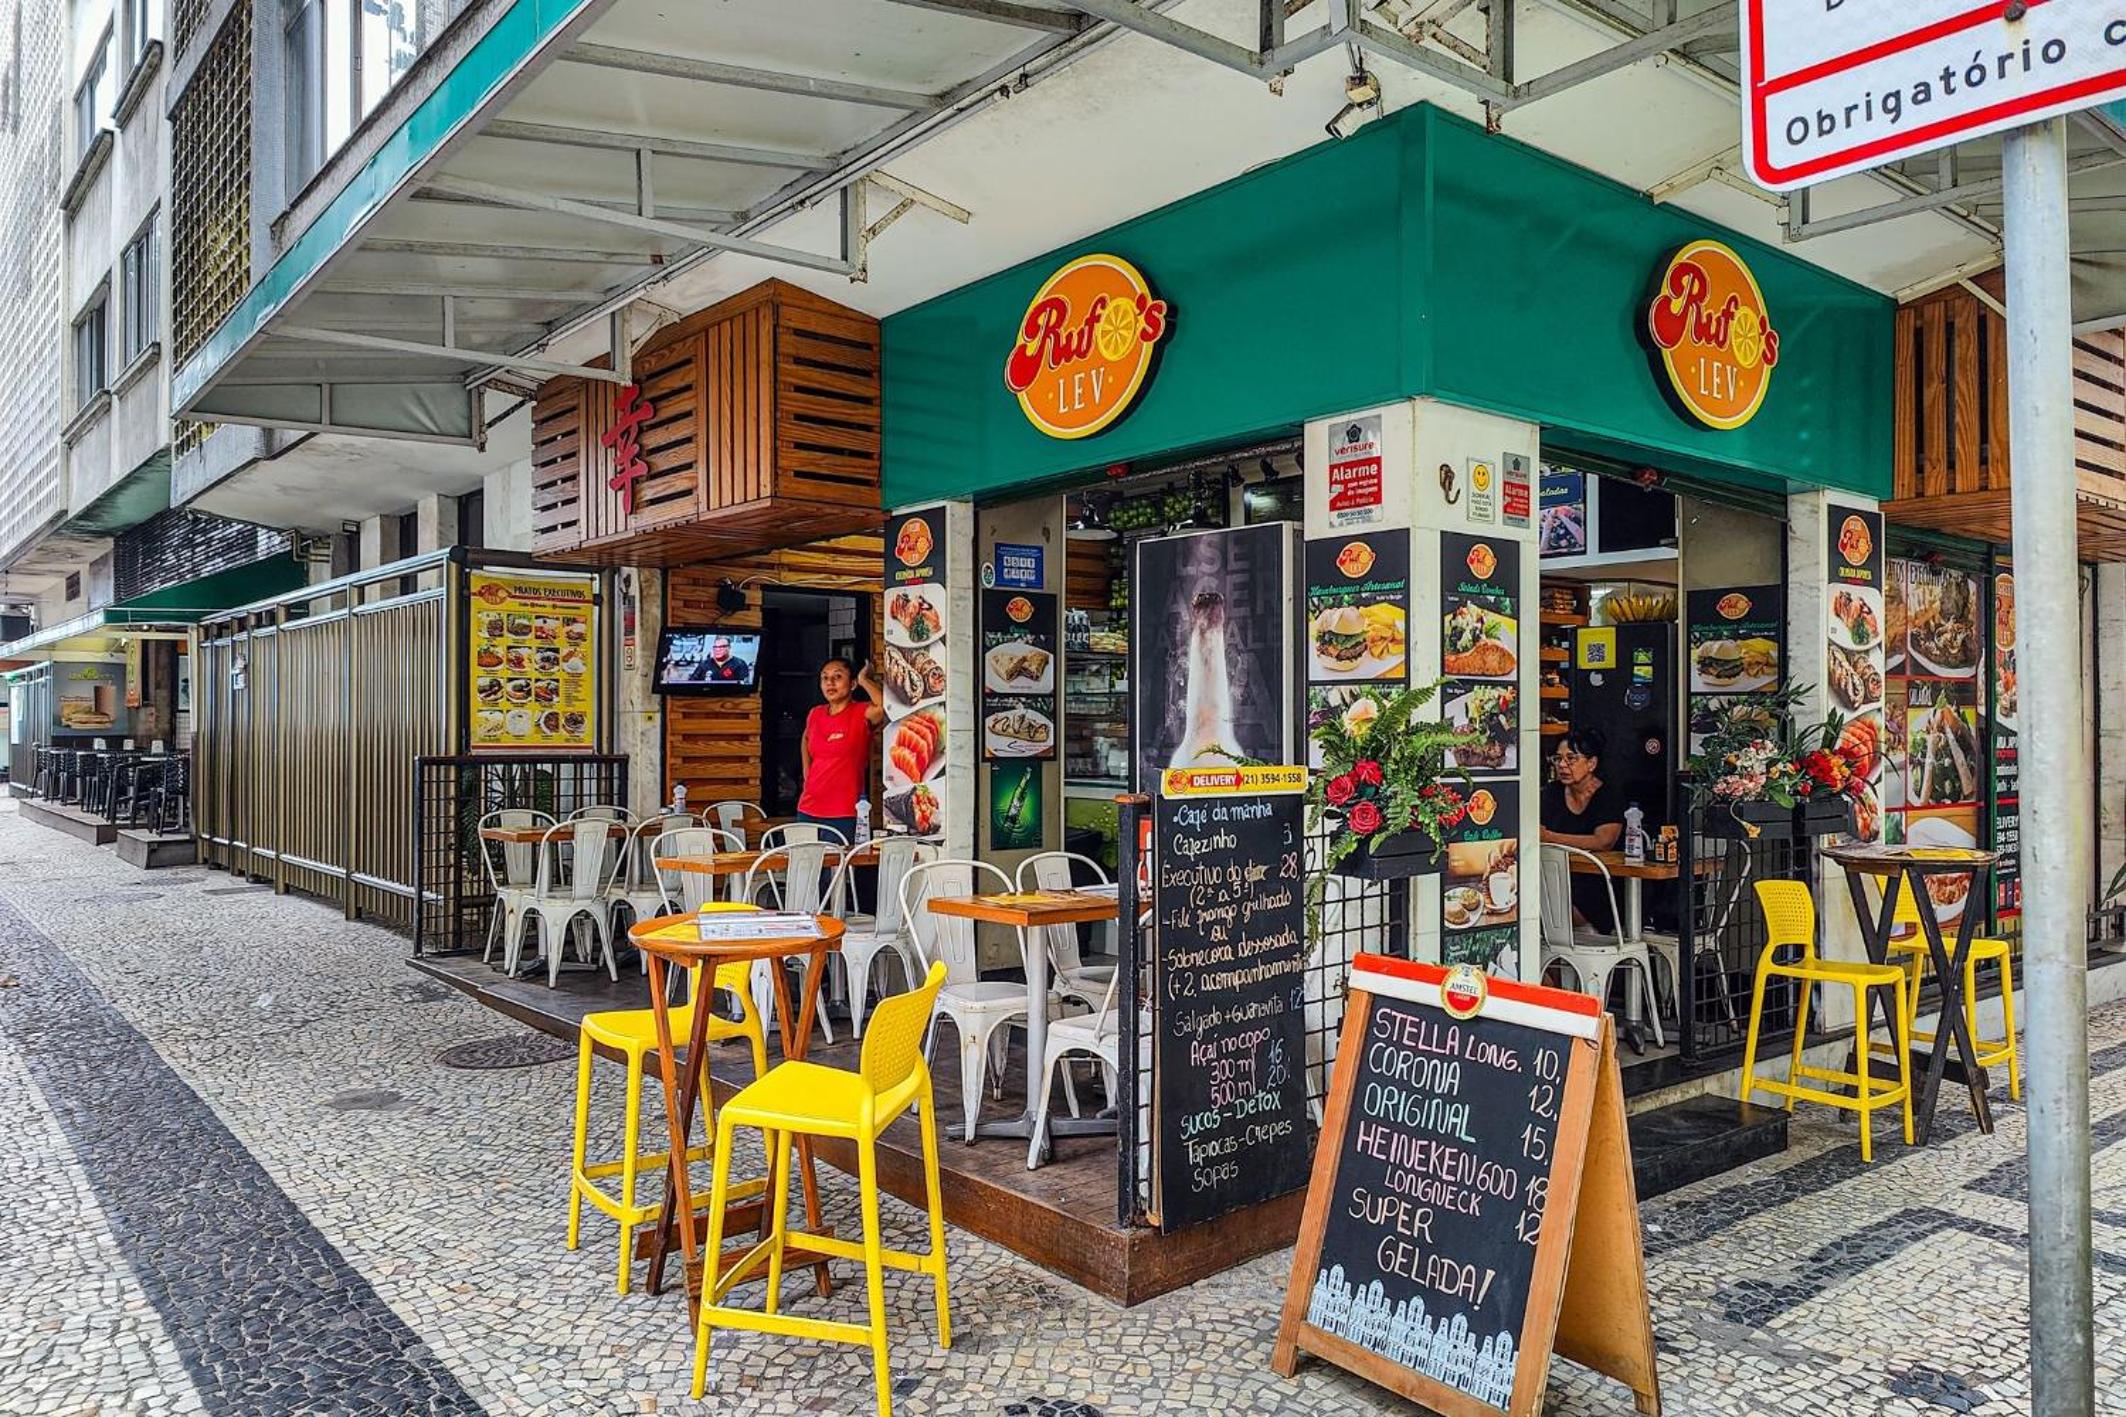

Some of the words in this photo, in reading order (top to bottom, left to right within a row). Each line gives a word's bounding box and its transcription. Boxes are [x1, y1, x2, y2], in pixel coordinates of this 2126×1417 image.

[1786, 38, 2066, 146] Obrigatório
[1059, 367, 1105, 413] LEV
[1700, 358, 1738, 402] LEV
[1334, 441, 1375, 456] verisure
[1331, 464, 1378, 481] Alarme
[514, 585, 541, 596] PRATOS
[543, 587, 586, 599] EXECUTIVOS
[1193, 774, 1237, 786] DELIVERY
[1243, 773, 1258, 786] (21)
[1260, 773, 1302, 784] 3594-1558
[1212, 800, 1229, 821] da
[1173, 827, 1237, 861] Cafezinho
[1283, 822, 1292, 845] 3
[1161, 859, 1223, 888] Executivo
[1226, 857, 1241, 882] do
[1218, 889, 1231, 902] a
[1210, 924, 1228, 942] ou
[1450, 981, 1478, 994] AMSTEL
[1173, 1005, 1222, 1040] Salgado
[1290, 987, 1304, 1011] 12
[1221, 1037, 1237, 1053] no
[1239, 1027, 1271, 1053] copo
[1373, 1008, 1460, 1056] STELLA
[1210, 1058, 1235, 1084] 300
[1368, 1042, 1461, 1096] CORONA
[1211, 1081, 1235, 1109] 500
[1364, 1082, 1477, 1143] ORIGINAL
[1357, 1120, 1477, 1186] HEINEKEN
[1385, 1164, 1482, 1216] LONGNECK
[1349, 1187, 1434, 1244] SUPER
[1376, 1235, 1496, 1311] GELADA!
